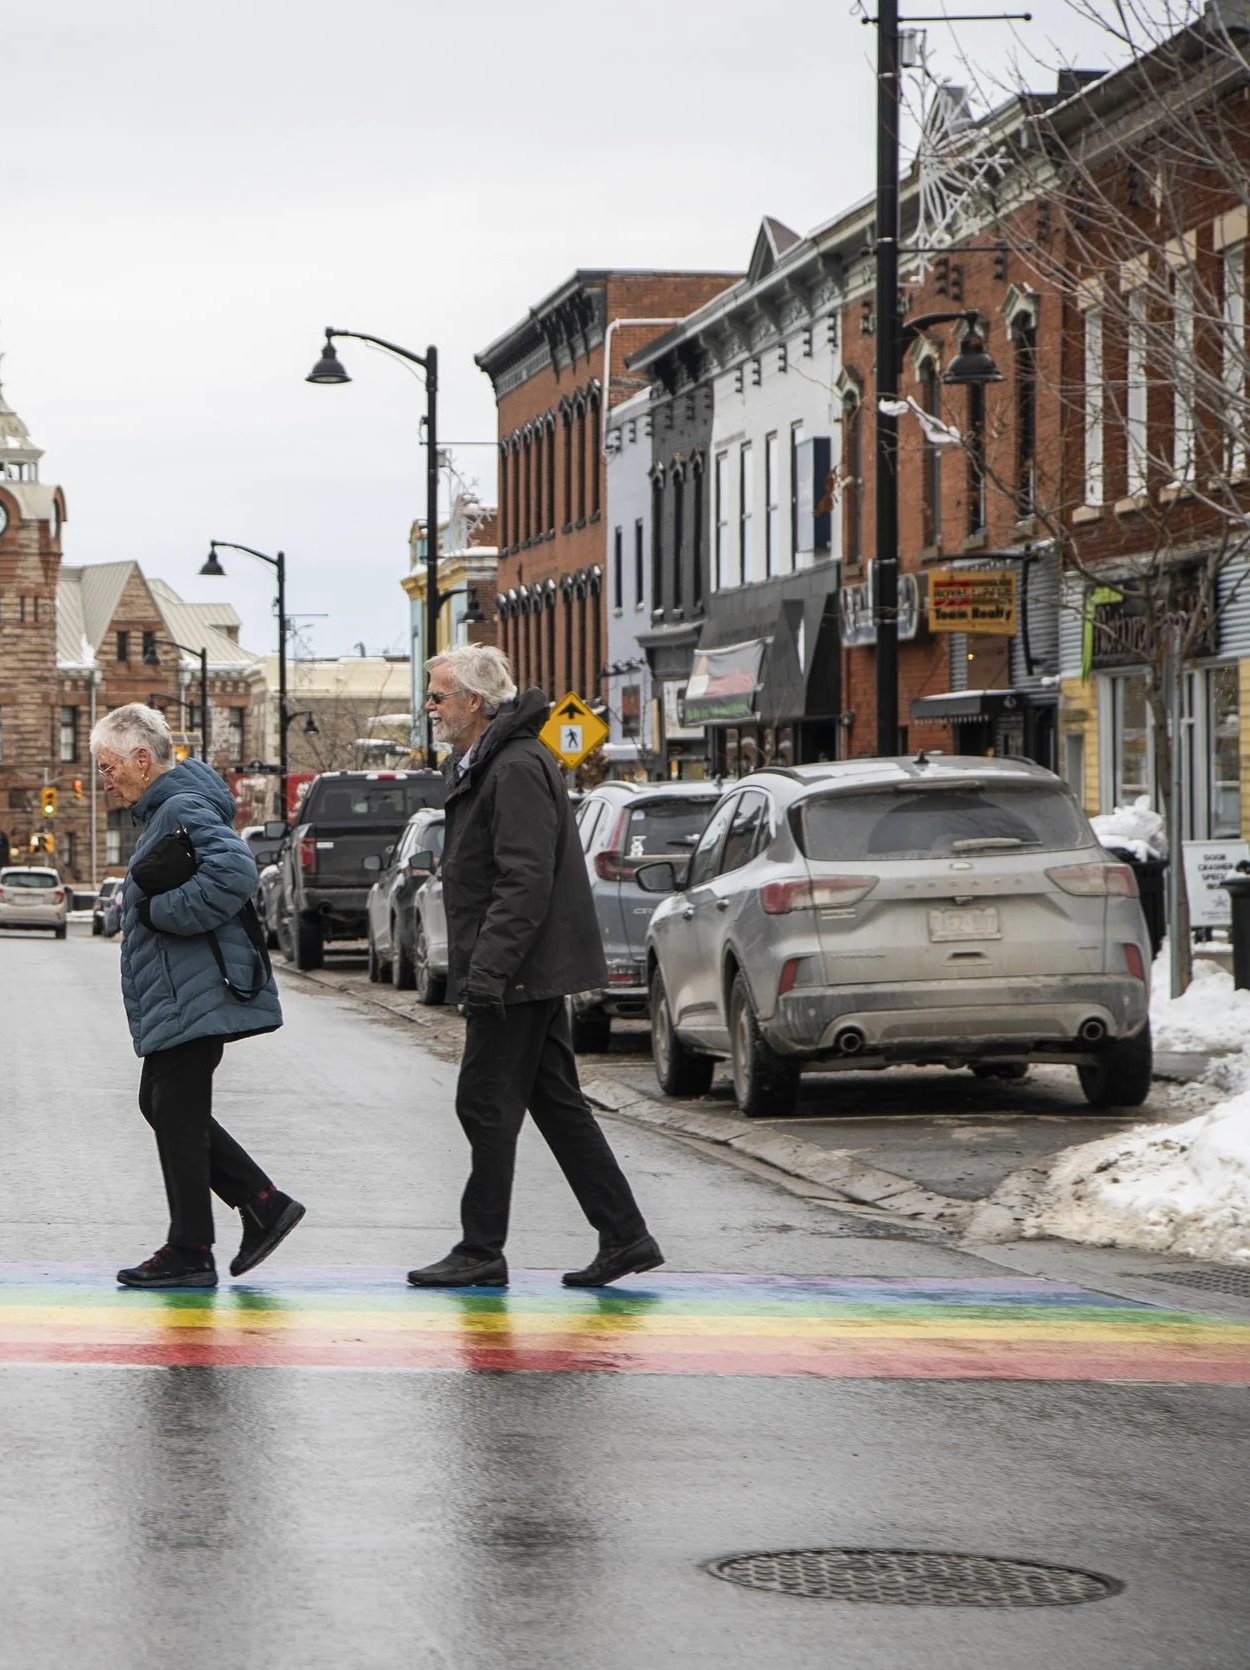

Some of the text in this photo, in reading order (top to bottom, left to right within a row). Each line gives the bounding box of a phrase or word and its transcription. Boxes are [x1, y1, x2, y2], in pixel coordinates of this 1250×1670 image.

[935, 605, 1012, 621] Team Realty
[1203, 853, 1227, 861] DOOR
